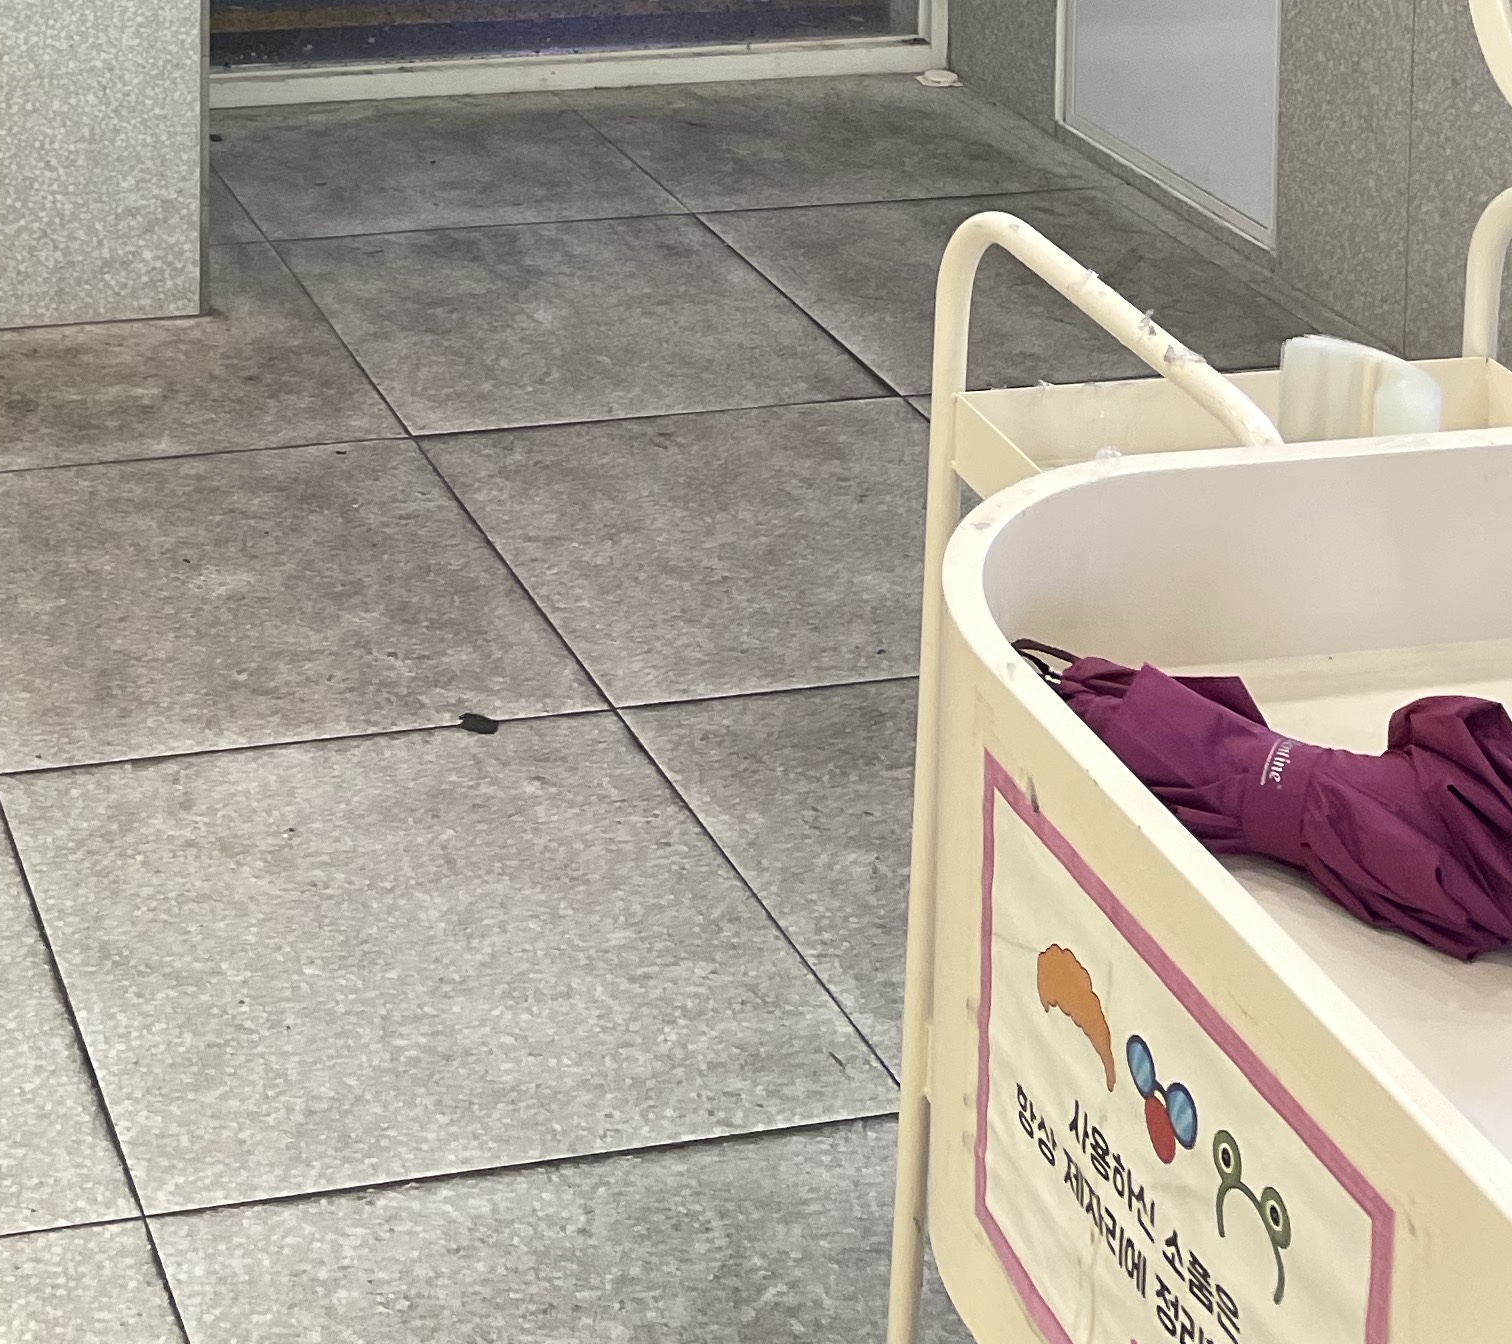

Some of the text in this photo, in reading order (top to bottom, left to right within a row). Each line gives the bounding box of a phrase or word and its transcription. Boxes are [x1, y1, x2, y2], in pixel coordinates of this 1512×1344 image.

[1016, 1082, 1058, 1167] 항상
[1063, 1147, 1147, 1299] 제자리에
[1068, 1099, 1240, 1344] 사용하신 소품은
